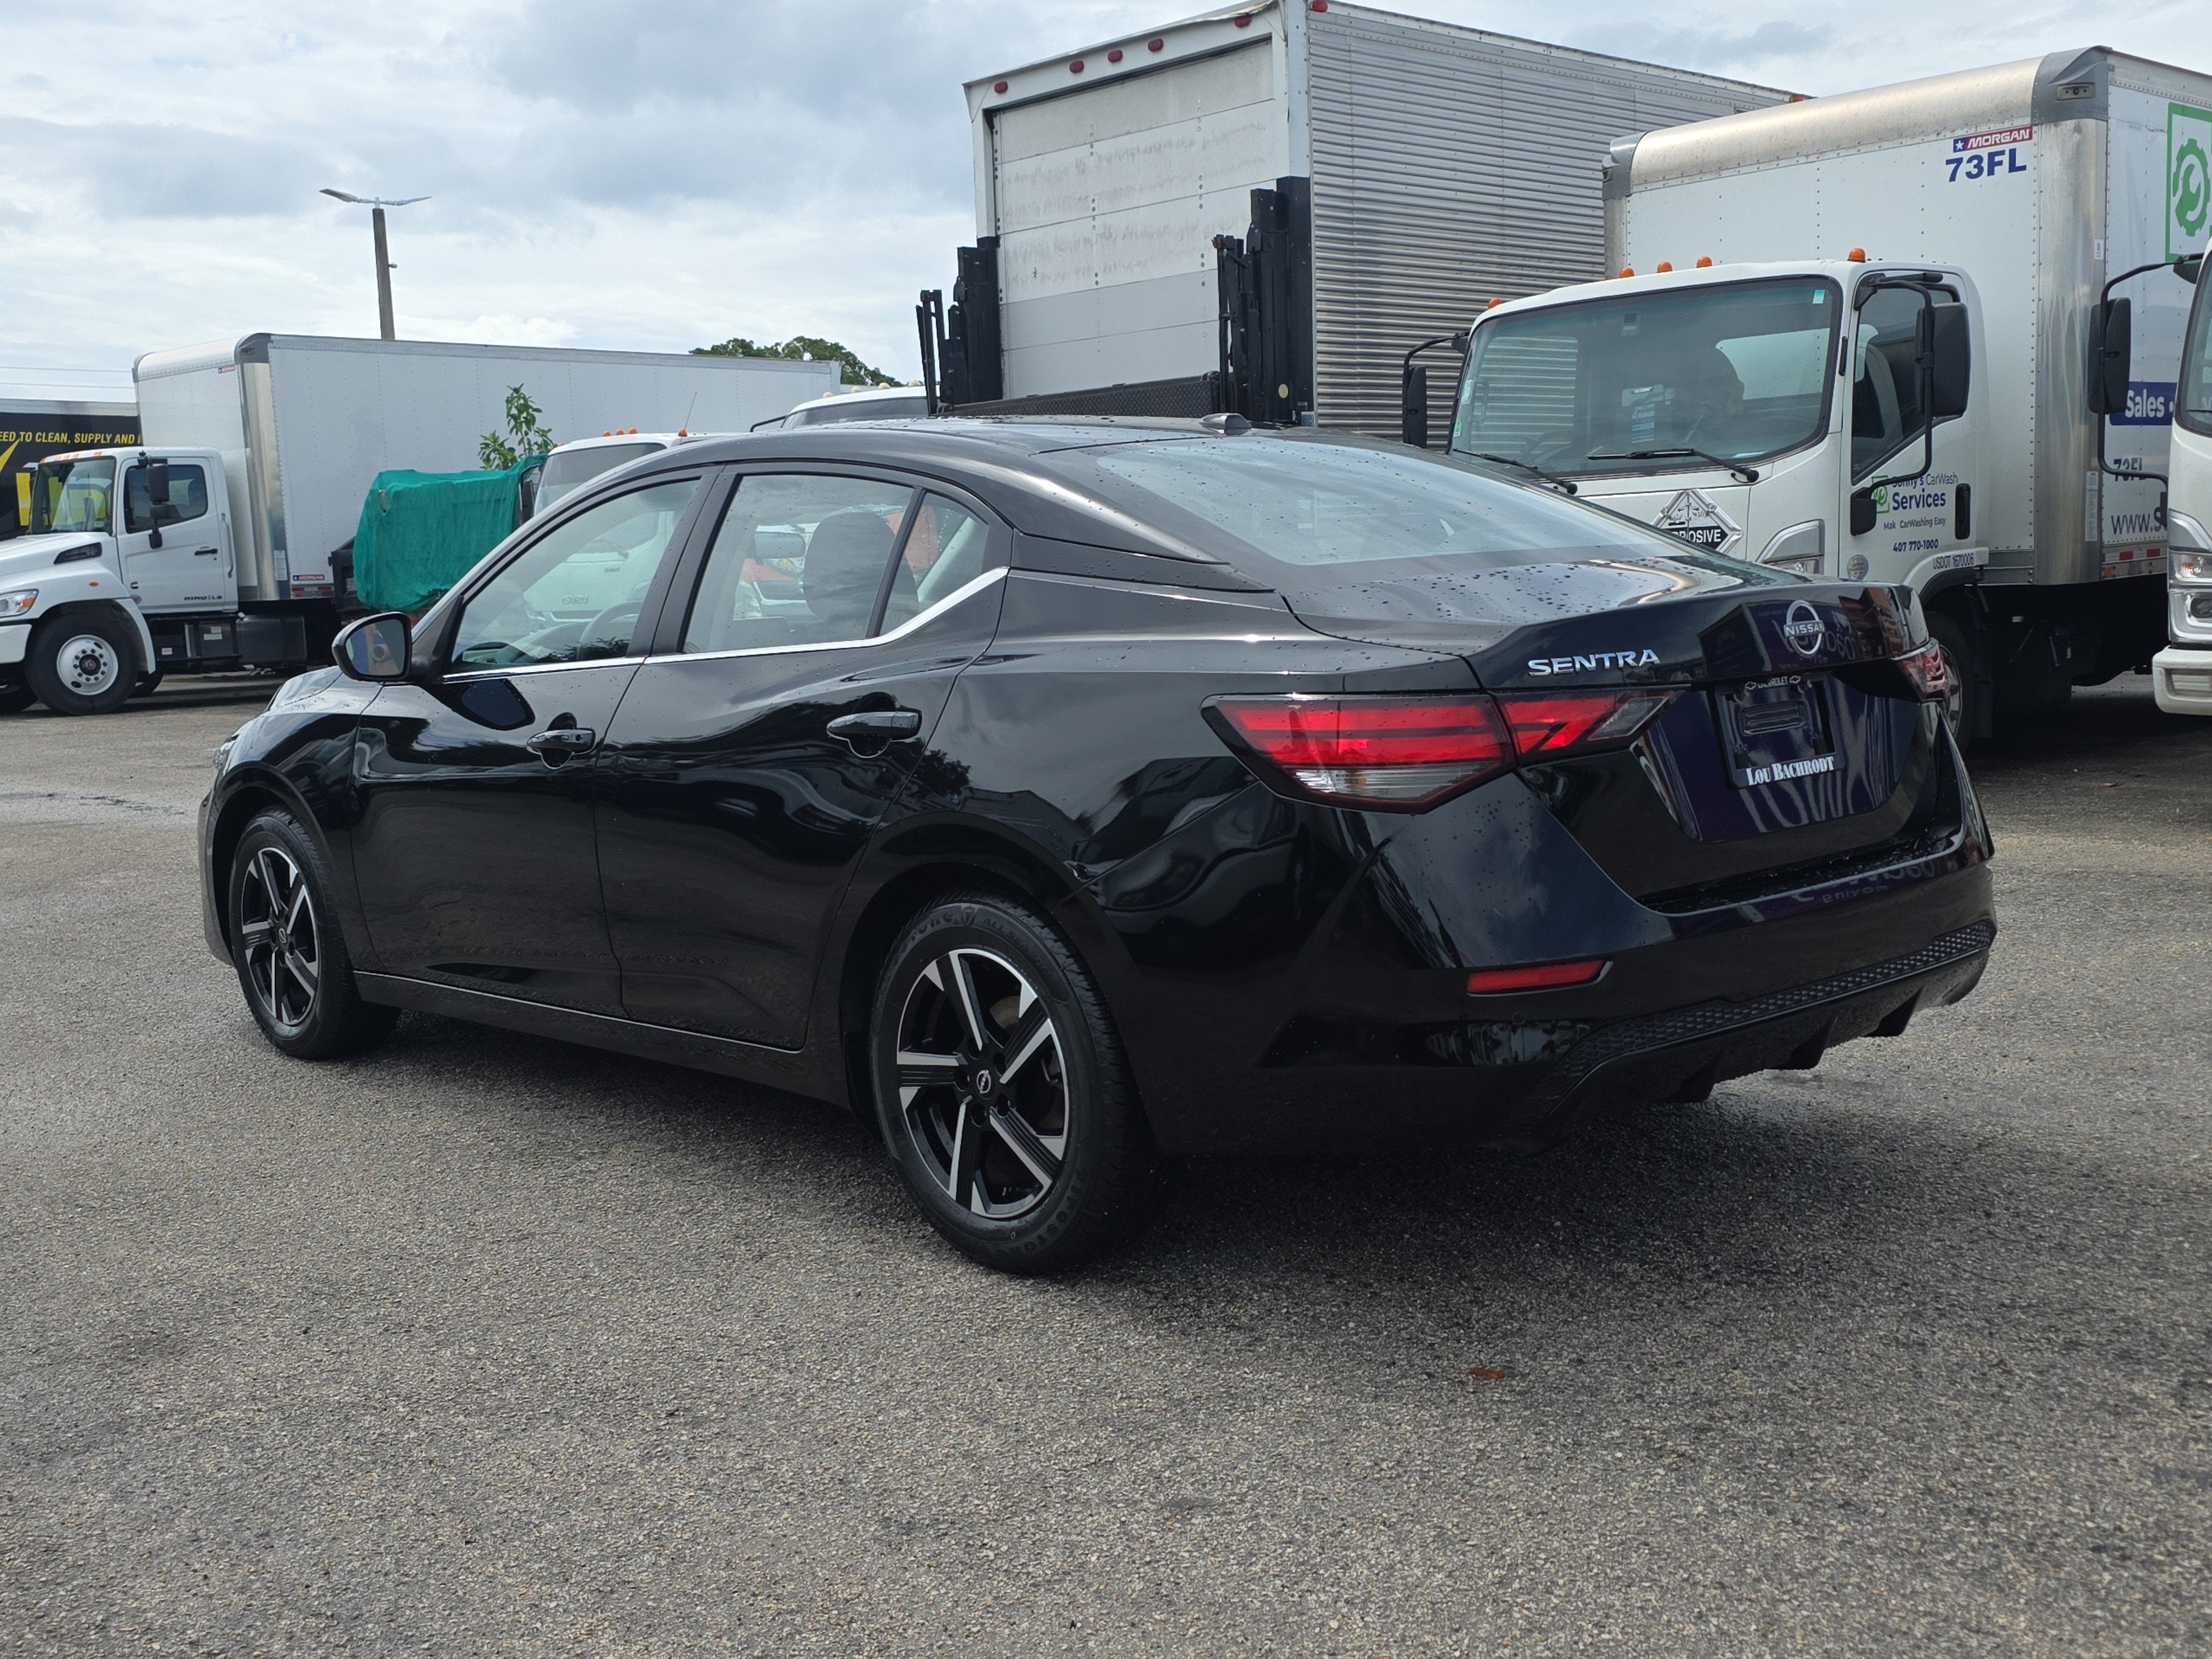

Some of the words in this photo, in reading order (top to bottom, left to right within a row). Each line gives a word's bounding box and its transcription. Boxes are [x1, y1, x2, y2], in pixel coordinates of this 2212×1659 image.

[1967, 129, 2030, 149] MORGAN
[1945, 147, 2027, 182] 73FL
[2125, 389, 2164, 418] Sales
[19, 432, 33, 442] TO
[35, 432, 71, 444] CLEAN,
[74, 434, 112, 444] SUPPLY
[114, 434, 134, 444] AND
[1926, 471, 1958, 486] CarWash
[1892, 488, 1946, 511] Services
[1900, 518, 1933, 529] CarWashing
[1934, 517, 1946, 527] Easy
[2111, 506, 2168, 535] www.S
[1671, 529, 1721, 543] ROSIVE
[1893, 542, 1907, 552] 407
[1909, 539, 1939, 551] 770-1000
[1932, 555, 1951, 569] USDOT
[1785, 623, 1824, 636] NISSAN
[1527, 649, 1661, 677] SENTRA
[1771, 756, 1835, 781] BACHRODT
